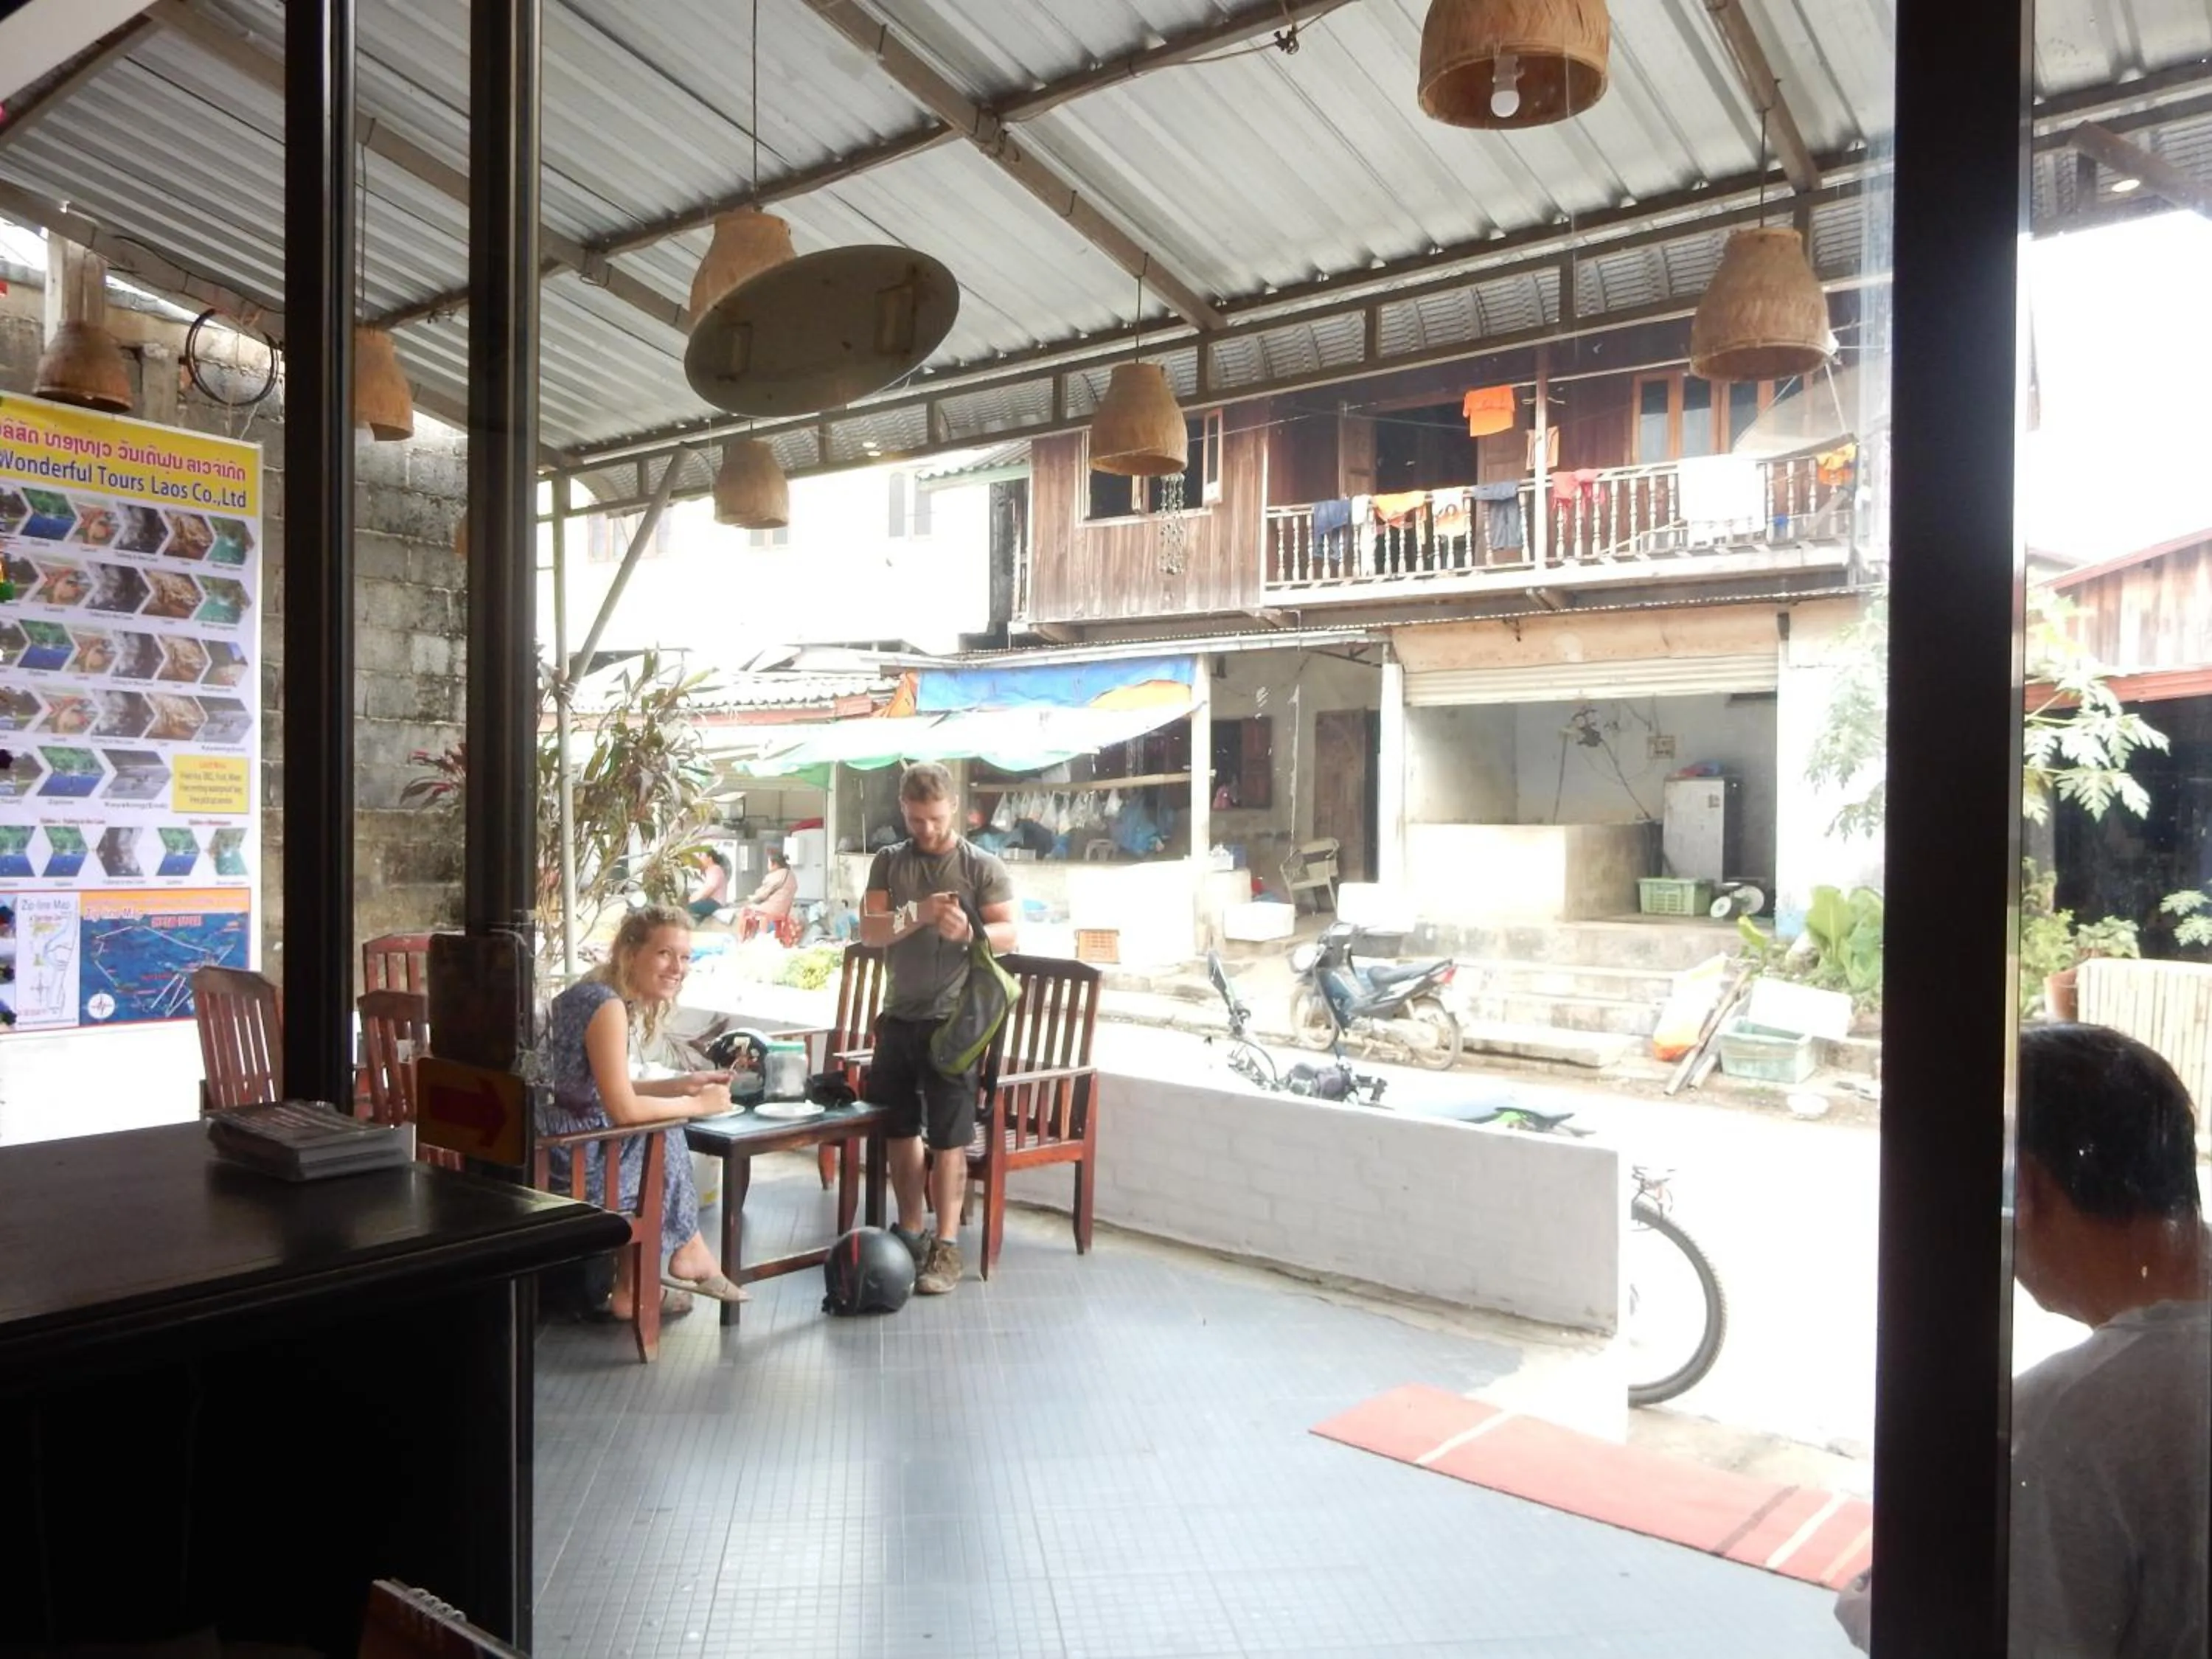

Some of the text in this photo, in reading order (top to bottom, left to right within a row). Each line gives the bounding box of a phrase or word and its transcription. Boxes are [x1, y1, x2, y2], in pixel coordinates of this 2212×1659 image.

[0, 449, 92, 483] Wonderful
[97, 465, 145, 492] Tours
[151, 476, 188, 499] Laos
